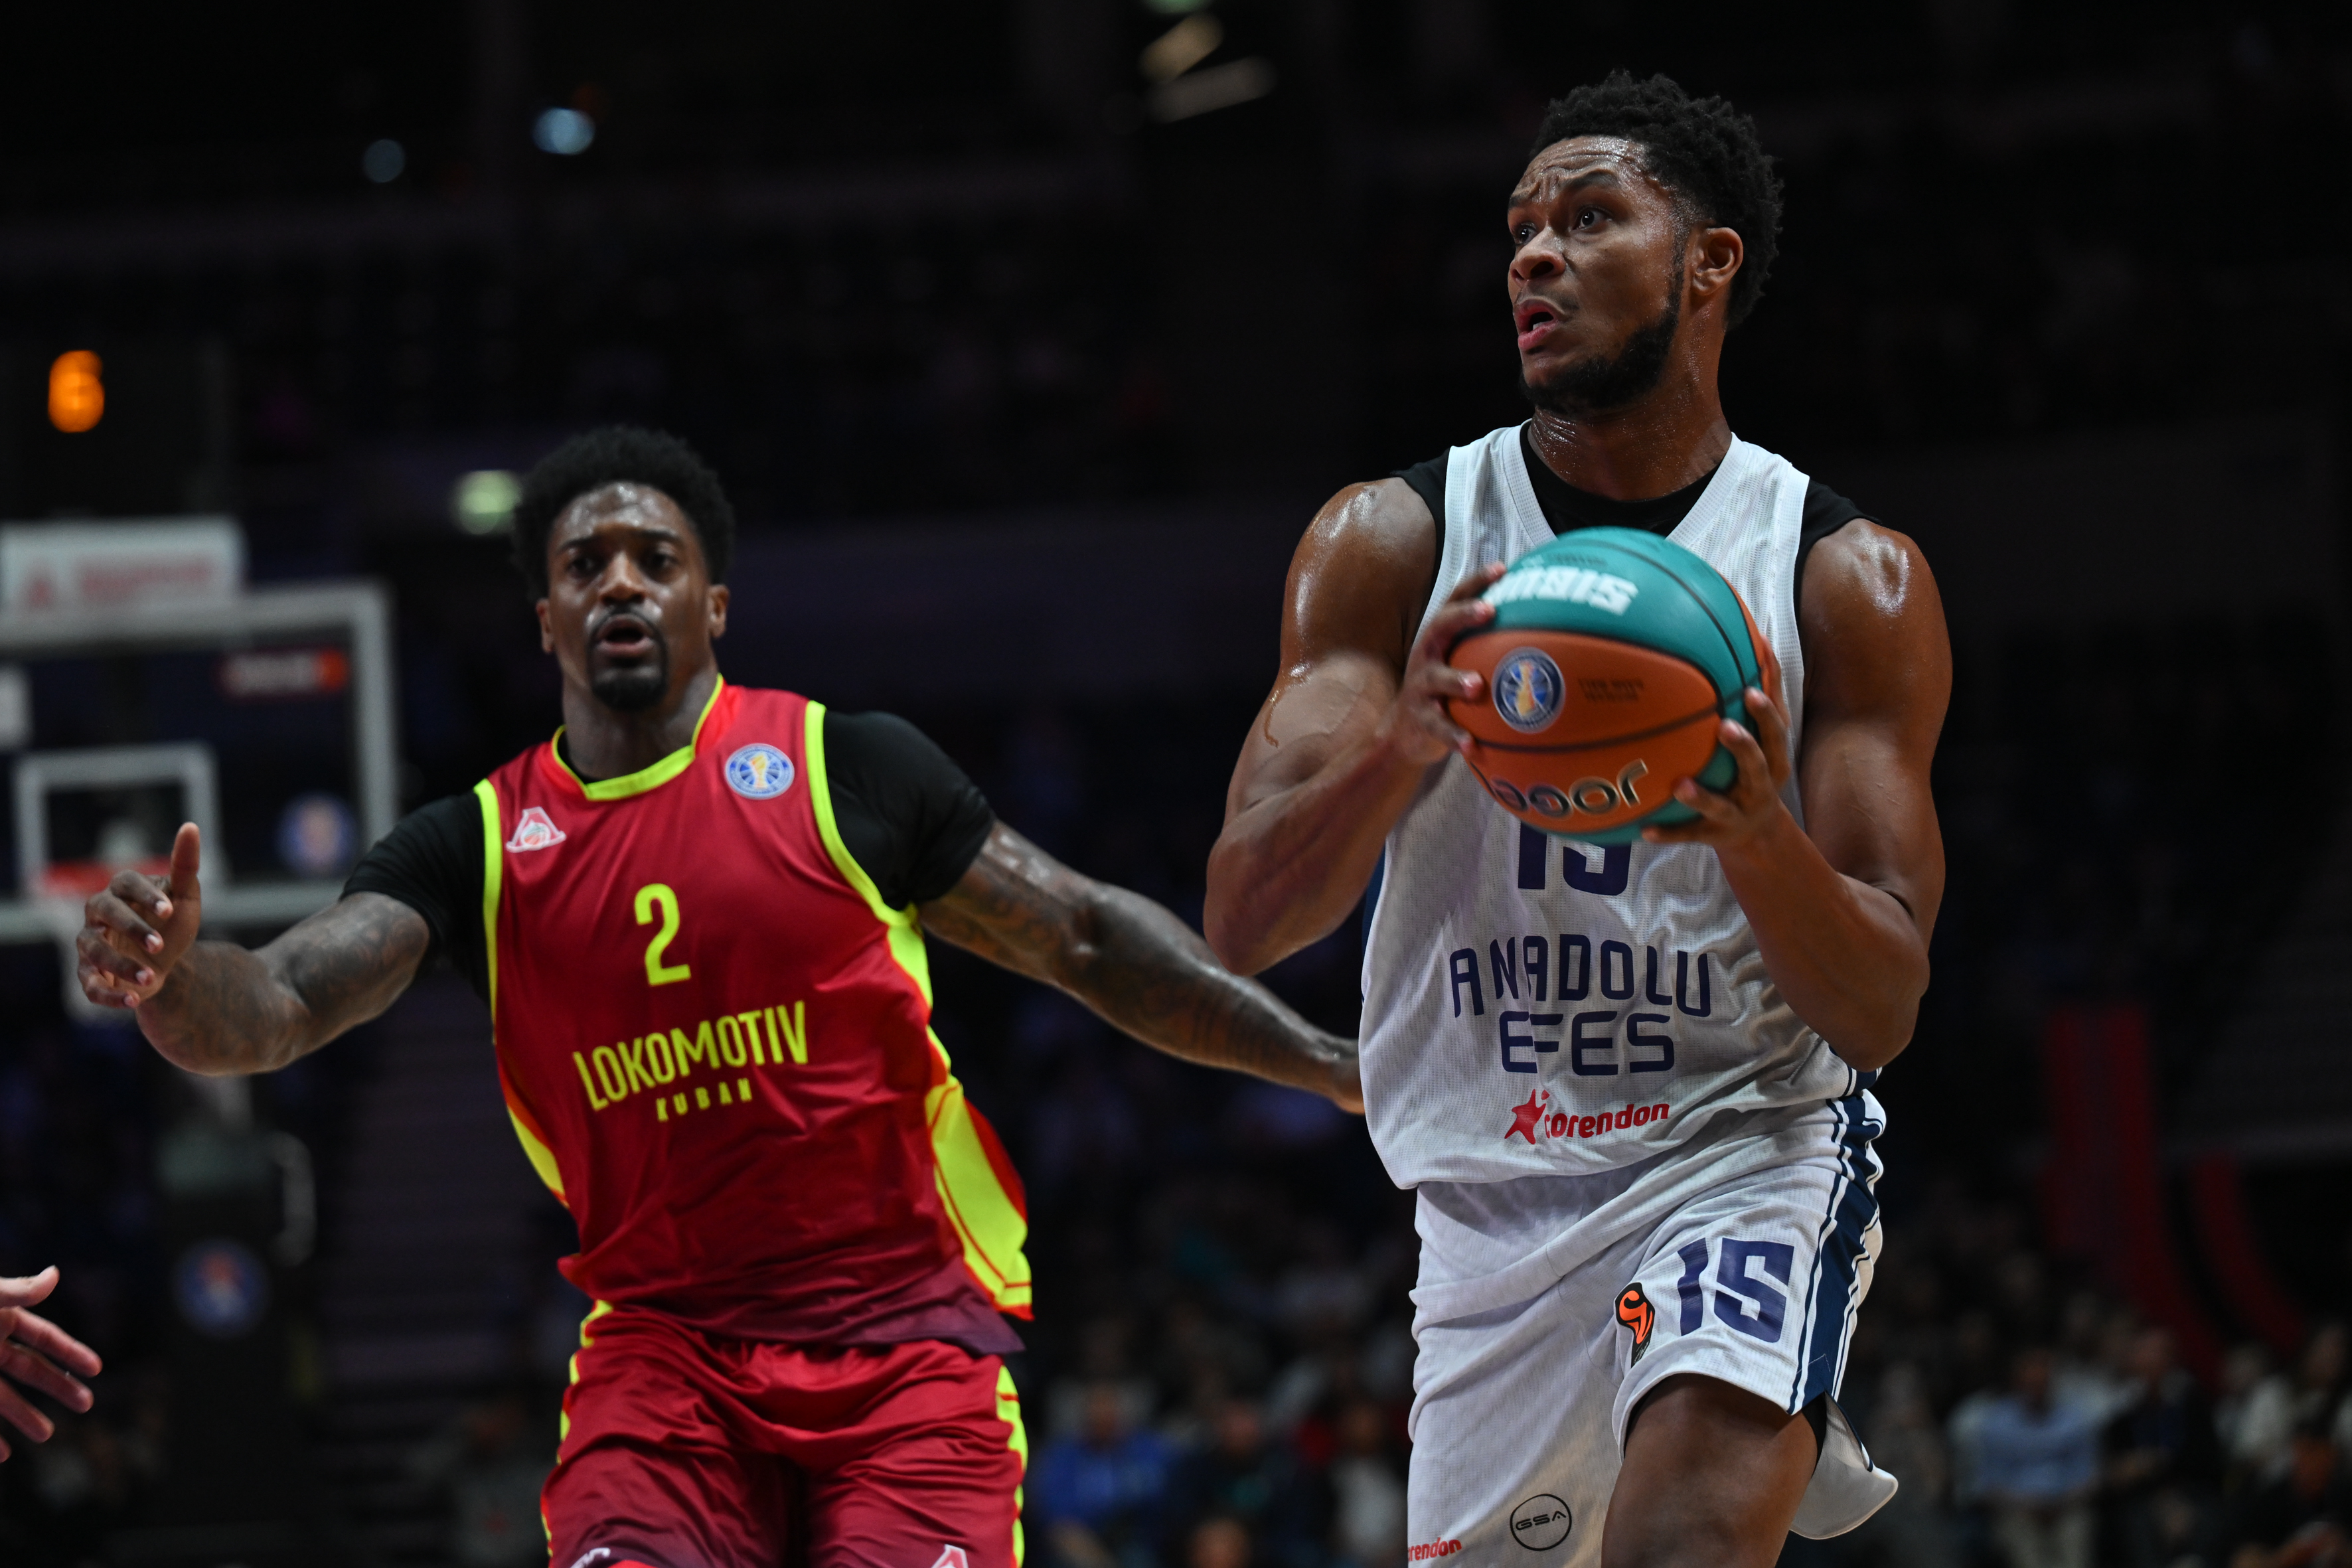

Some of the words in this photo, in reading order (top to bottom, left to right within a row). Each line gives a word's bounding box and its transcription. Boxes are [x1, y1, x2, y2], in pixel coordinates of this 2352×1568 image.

[635, 883, 691, 986] 2
[1449, 933, 1711, 1018] ANADOLU
[574, 1001, 808, 1111] LOKOMOTIV
[1499, 1010, 1675, 1076] EFES
[655, 1077, 753, 1123] KUBAN
[1544, 1103, 1670, 1139] corendon
[1676, 1237, 1795, 1344] 15
[1516, 1510, 1567, 1531] GSA
